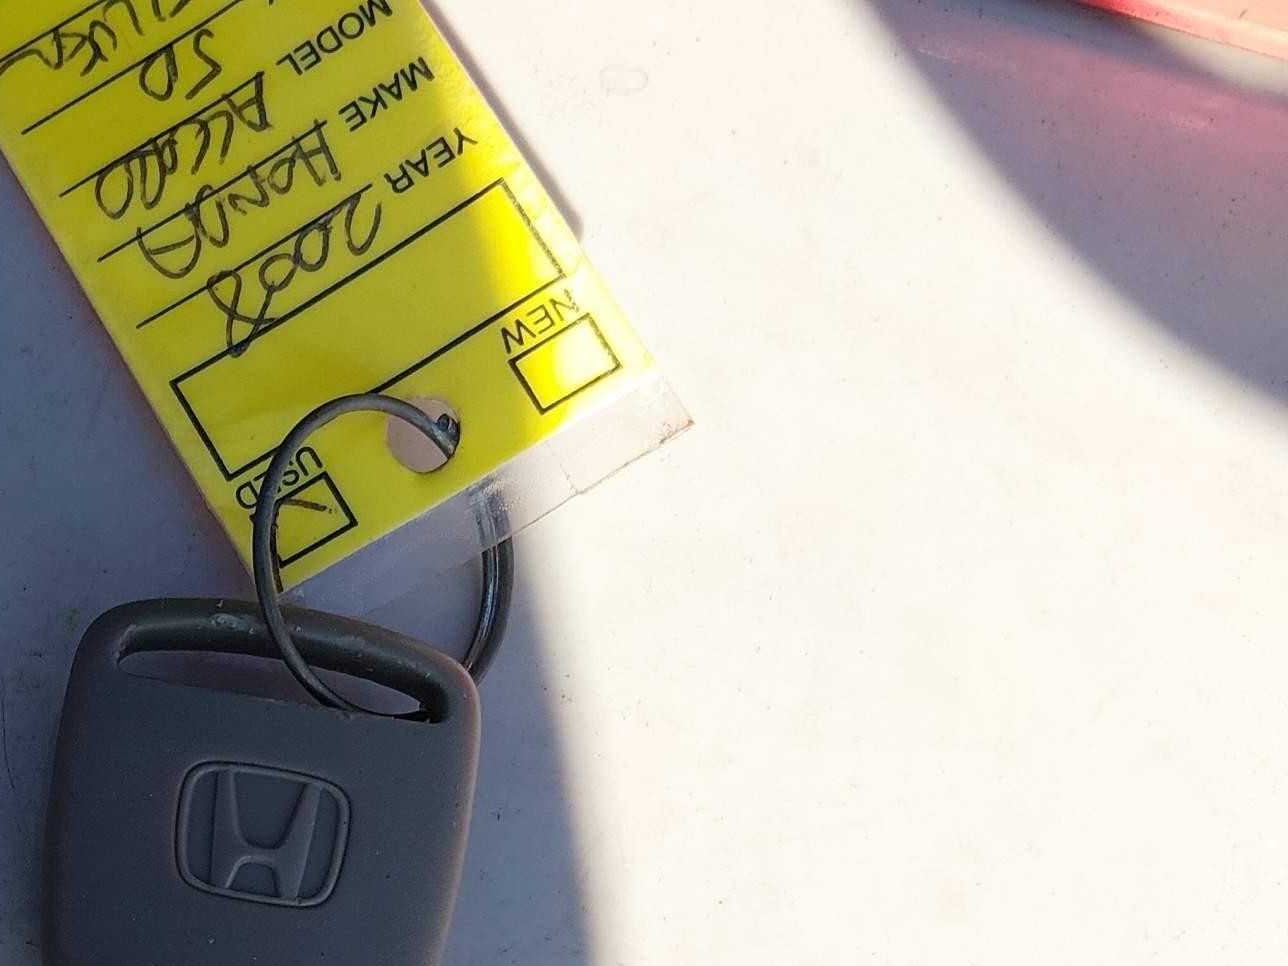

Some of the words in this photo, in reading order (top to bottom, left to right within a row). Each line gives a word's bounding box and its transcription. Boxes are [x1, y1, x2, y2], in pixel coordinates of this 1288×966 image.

[276, 0, 393, 76] MODEL
[338, 56, 435, 132] MAKE
[383, 127, 478, 193] YEAR
[136, 120, 342, 279] HONDA
[207, 192, 382, 358] 2008
[500, 288, 580, 354] NEW
